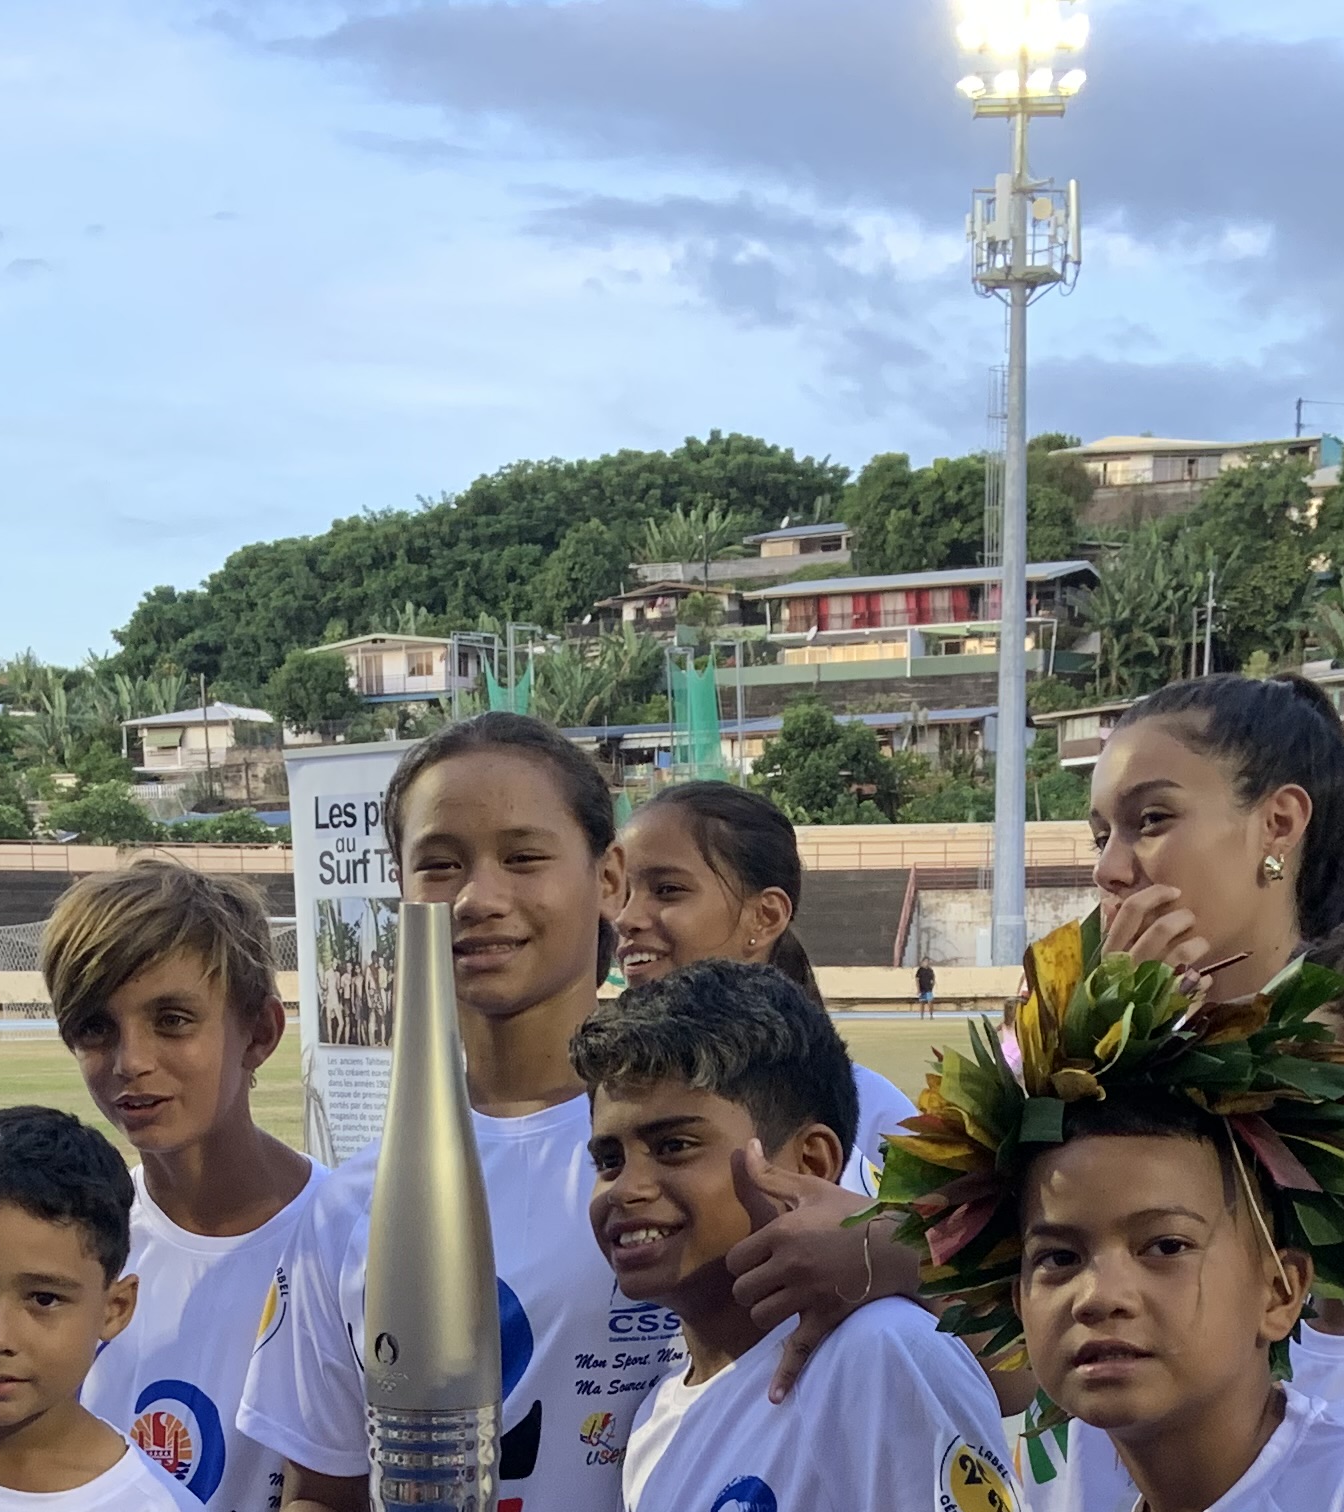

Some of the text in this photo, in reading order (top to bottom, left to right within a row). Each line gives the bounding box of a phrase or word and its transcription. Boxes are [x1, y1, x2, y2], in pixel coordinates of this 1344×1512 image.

[314, 791, 385, 836] Les pi
[336, 837, 356, 853] au
[319, 848, 370, 885] Surf
[276, 1267, 289, 1297] ABEL
[608, 1311, 681, 1333] CSS
[575, 1354, 607, 1369] Mon
[657, 1347, 683, 1363] Mon
[575, 1379, 601, 1395] Ma
[607, 1379, 647, 1395] Source
[978, 1446, 1009, 1478] LABEL
